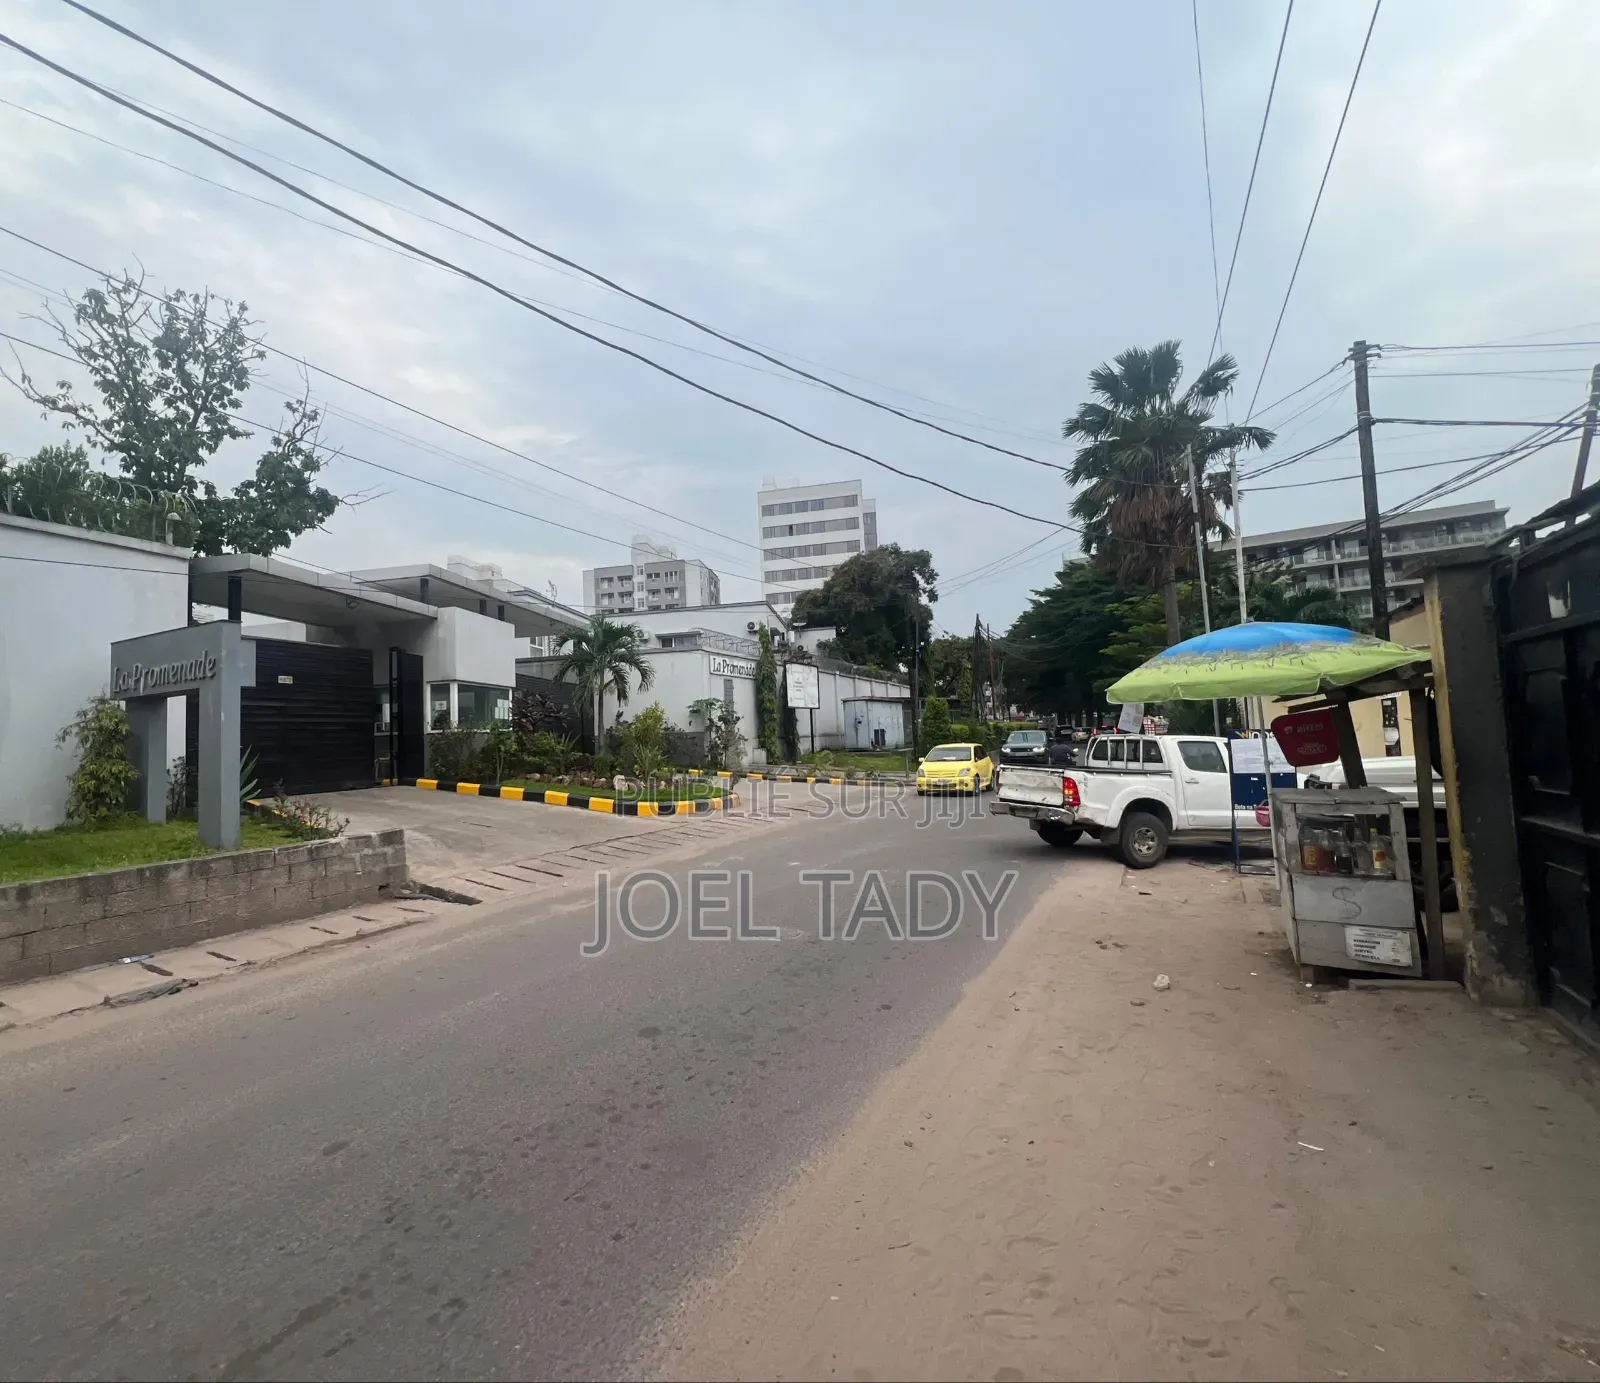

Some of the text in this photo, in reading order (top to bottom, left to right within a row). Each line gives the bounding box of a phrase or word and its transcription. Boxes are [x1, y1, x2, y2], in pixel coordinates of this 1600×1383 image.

[112, 649, 216, 694] La Promenade
[713, 657, 755, 678] La Promenade
